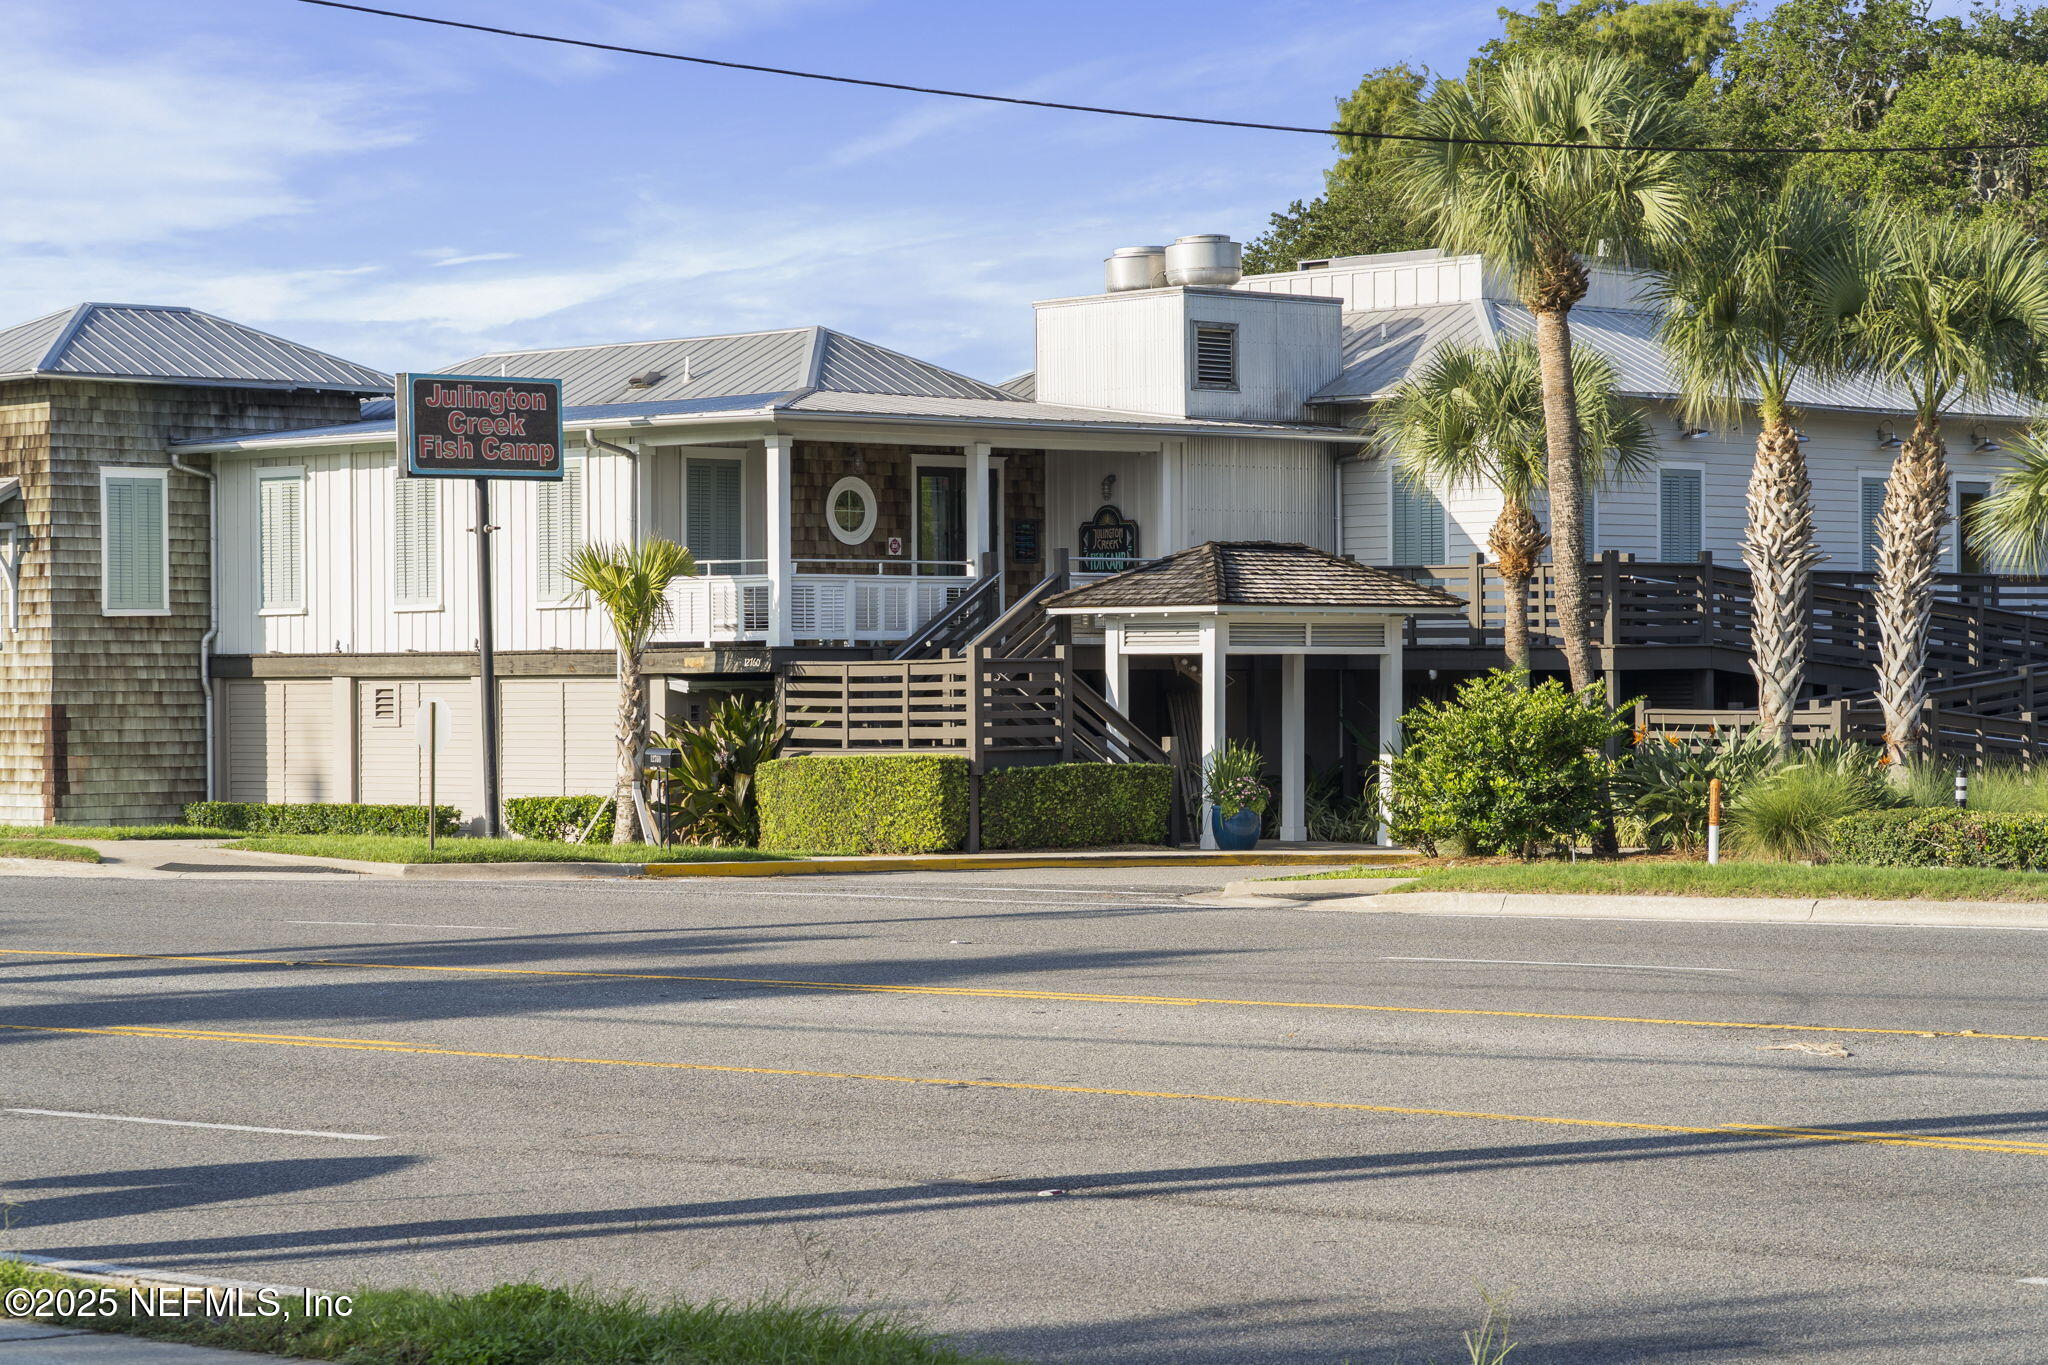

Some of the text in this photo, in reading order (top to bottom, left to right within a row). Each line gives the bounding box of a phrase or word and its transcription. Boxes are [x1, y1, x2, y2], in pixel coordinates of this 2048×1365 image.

[425, 383, 547, 415] Julington
[447, 410, 526, 436] Creek
[418, 434, 555, 467] Fish Camp
[1097, 538, 1120, 550] CREEK
